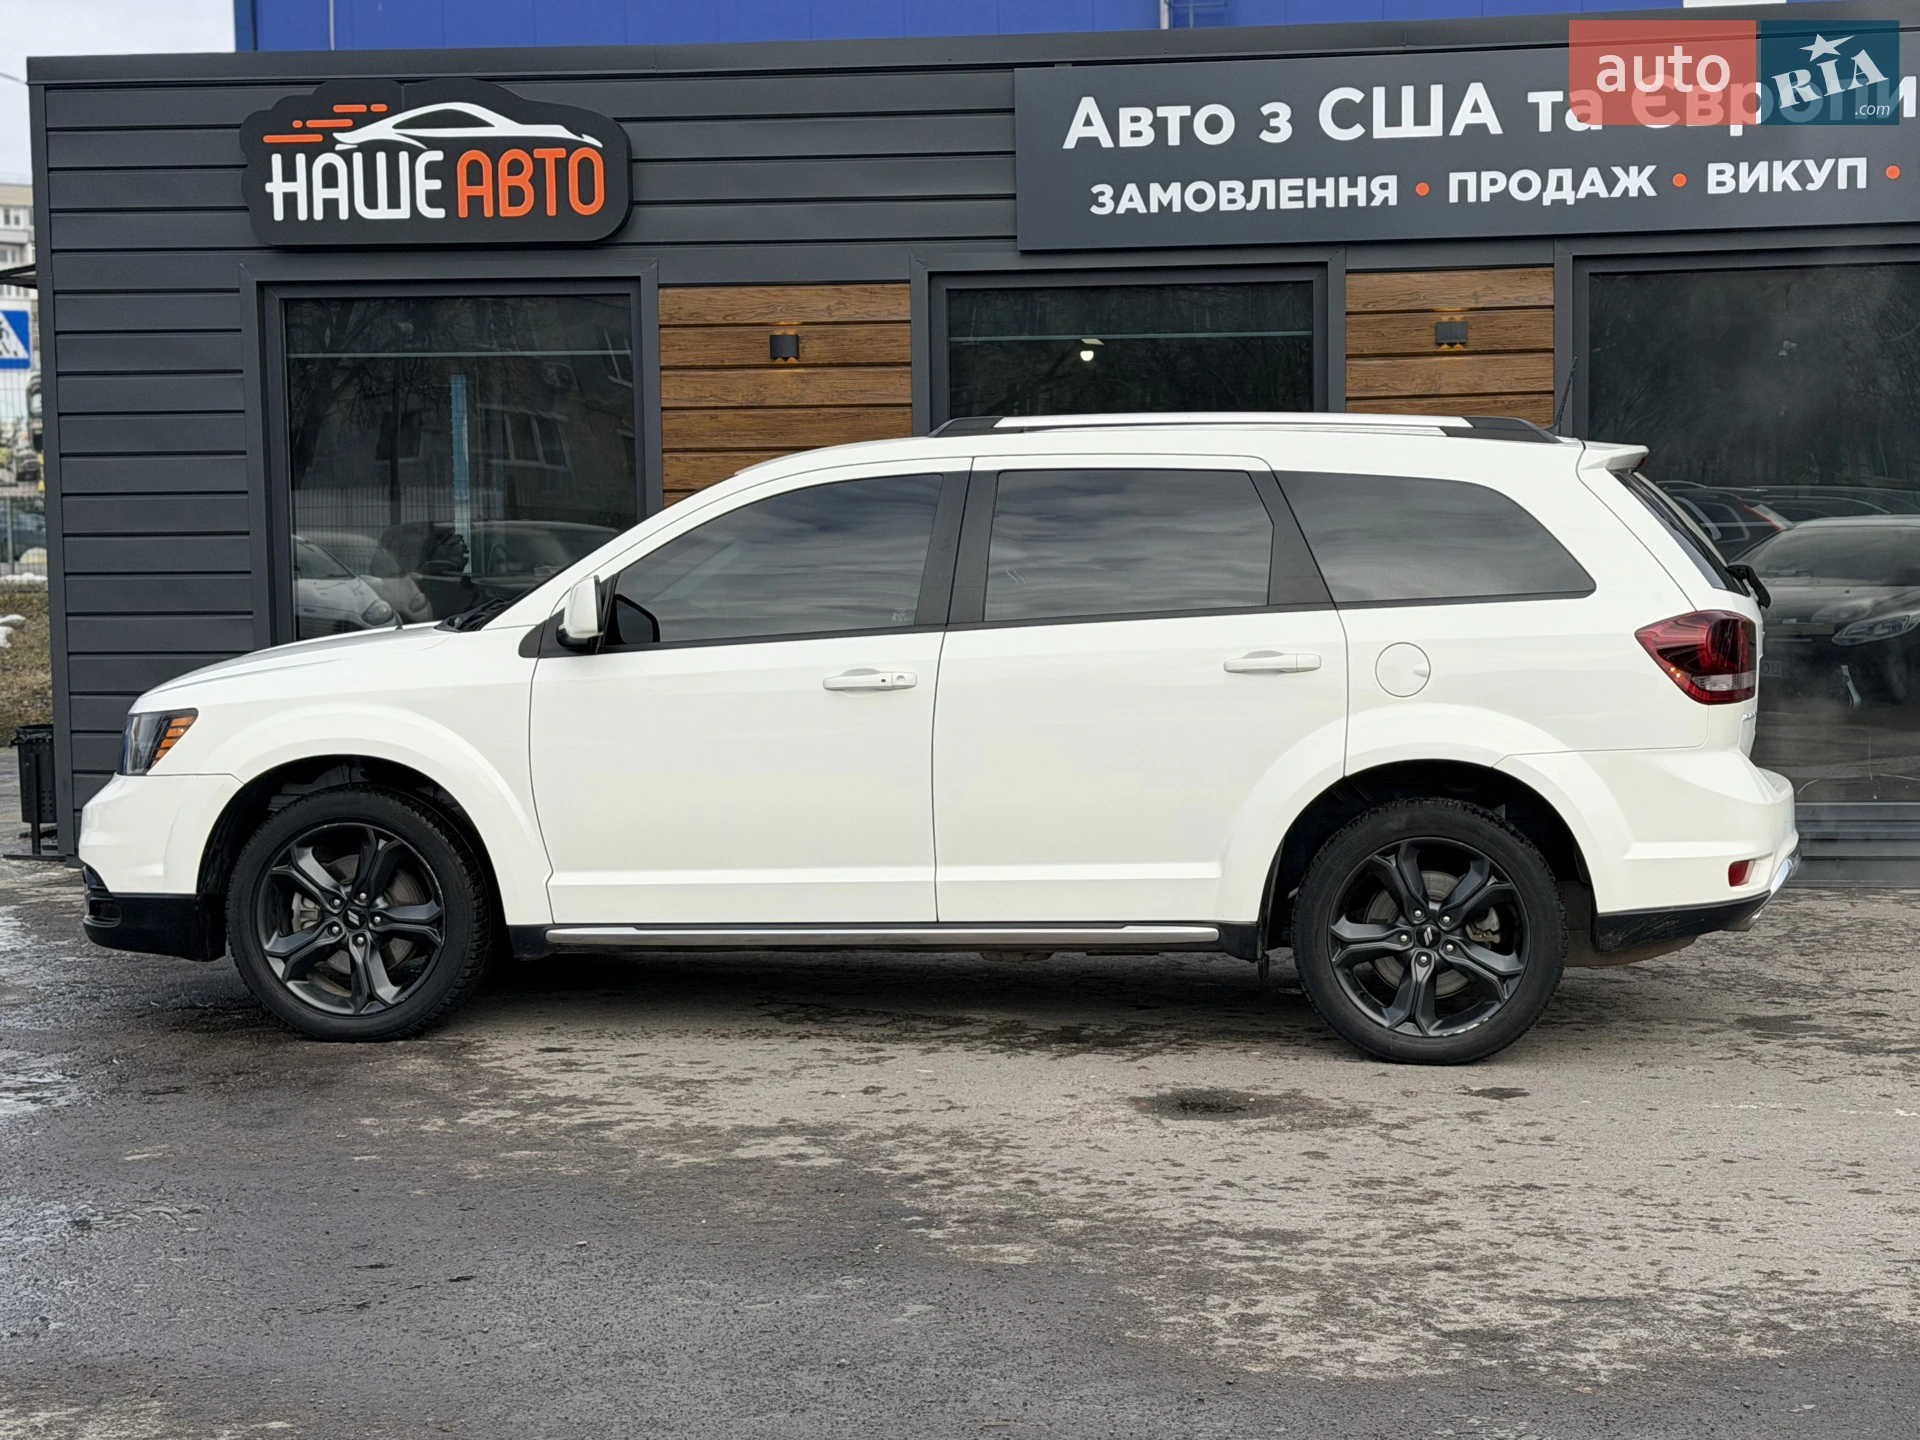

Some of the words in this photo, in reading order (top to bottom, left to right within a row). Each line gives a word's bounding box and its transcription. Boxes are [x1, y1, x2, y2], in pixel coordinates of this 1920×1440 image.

[1062, 96, 1236, 149] Авто
[1259, 101, 1293, 144] з
[1318, 82, 1504, 141] США
[1528, 90, 1603, 132] та
[1631, 74, 1917, 136] Європи
[265, 150, 446, 221] НАШЕ
[456, 146, 605, 218] АВТО
[1090, 174, 1398, 215] ЗАМОВЛЕННЯ
[1448, 164, 1658, 206] ПРОДАЖ
[1707, 156, 1868, 195] ВИКУП
